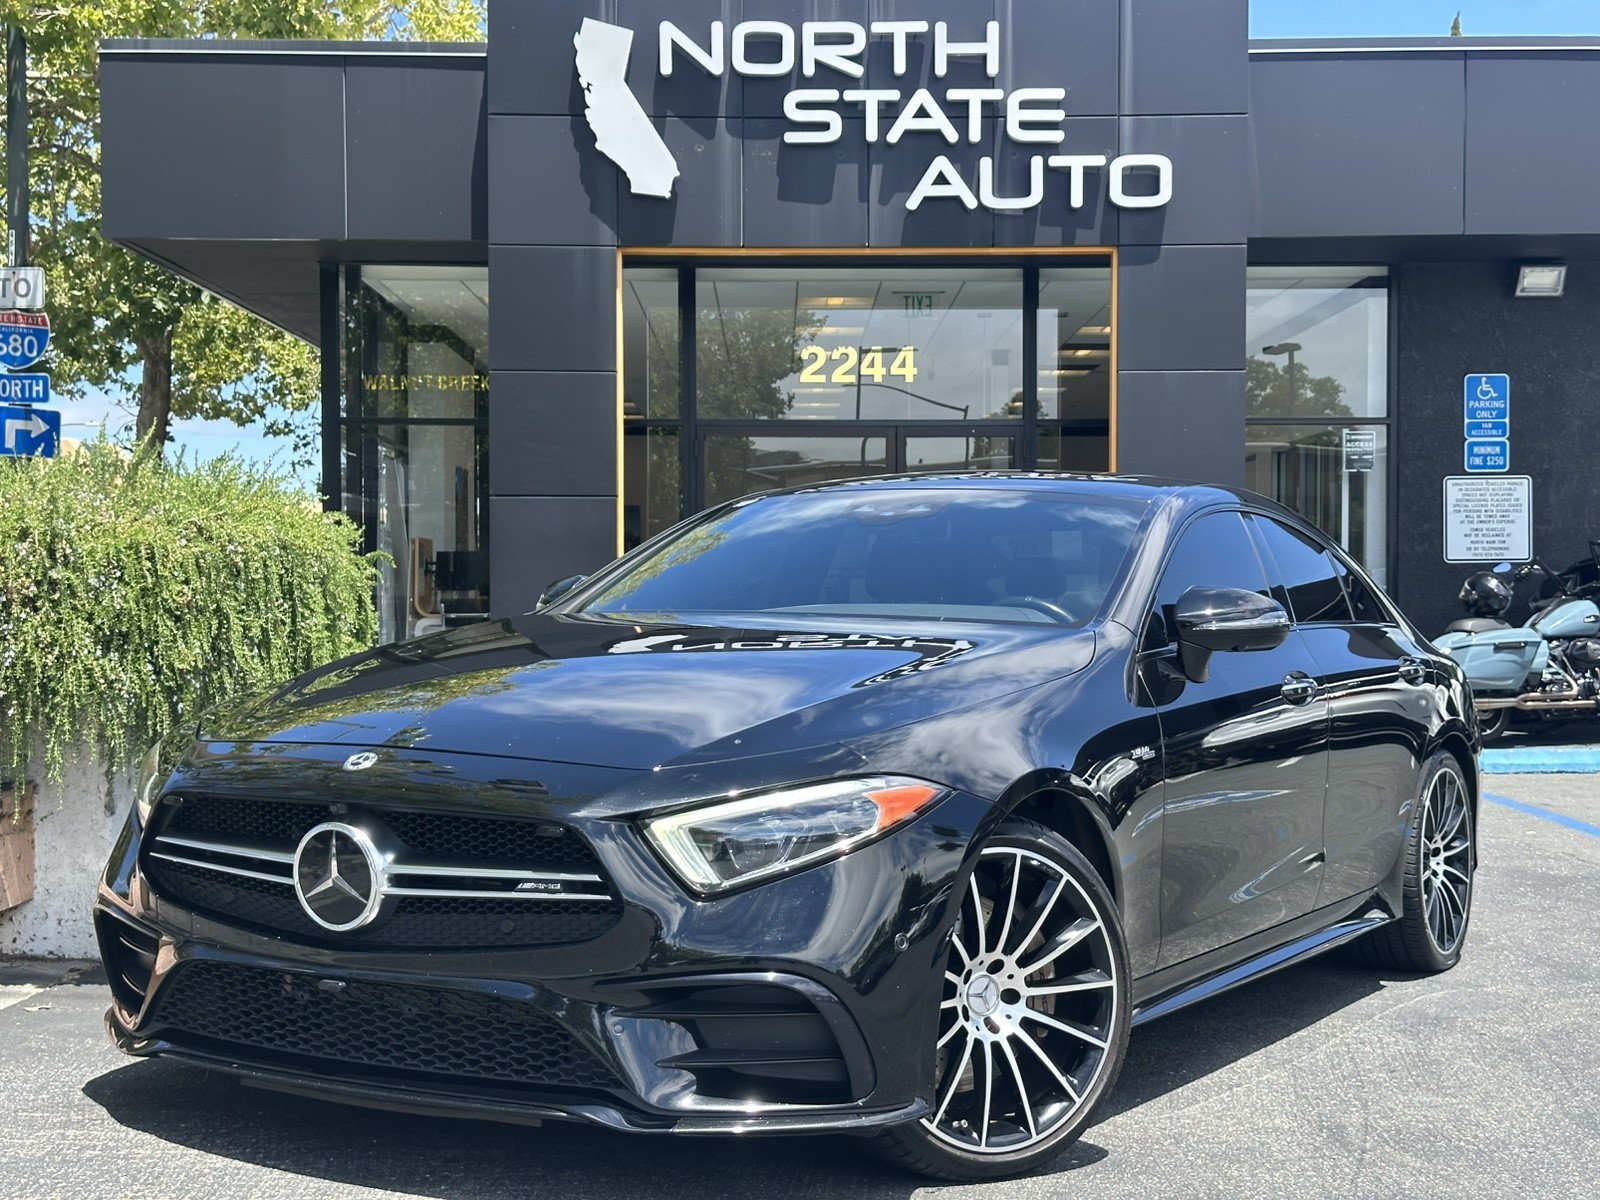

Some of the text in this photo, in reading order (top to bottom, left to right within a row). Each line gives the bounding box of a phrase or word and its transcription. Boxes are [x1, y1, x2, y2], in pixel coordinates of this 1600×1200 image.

[659, 20, 999, 78] NORTH
[783, 88, 1066, 144] STATE
[905, 154, 1173, 210] AUTO
[0, 278, 31, 298] TO
[799, 345, 917, 383] 2244
[0, 379, 44, 398] ORTH
[1469, 400, 1505, 408] PARKING
[1476, 410, 1498, 418] ONLY
[1473, 446, 1500, 454] MINIMUM
[1469, 456, 1504, 466] FINE $250
